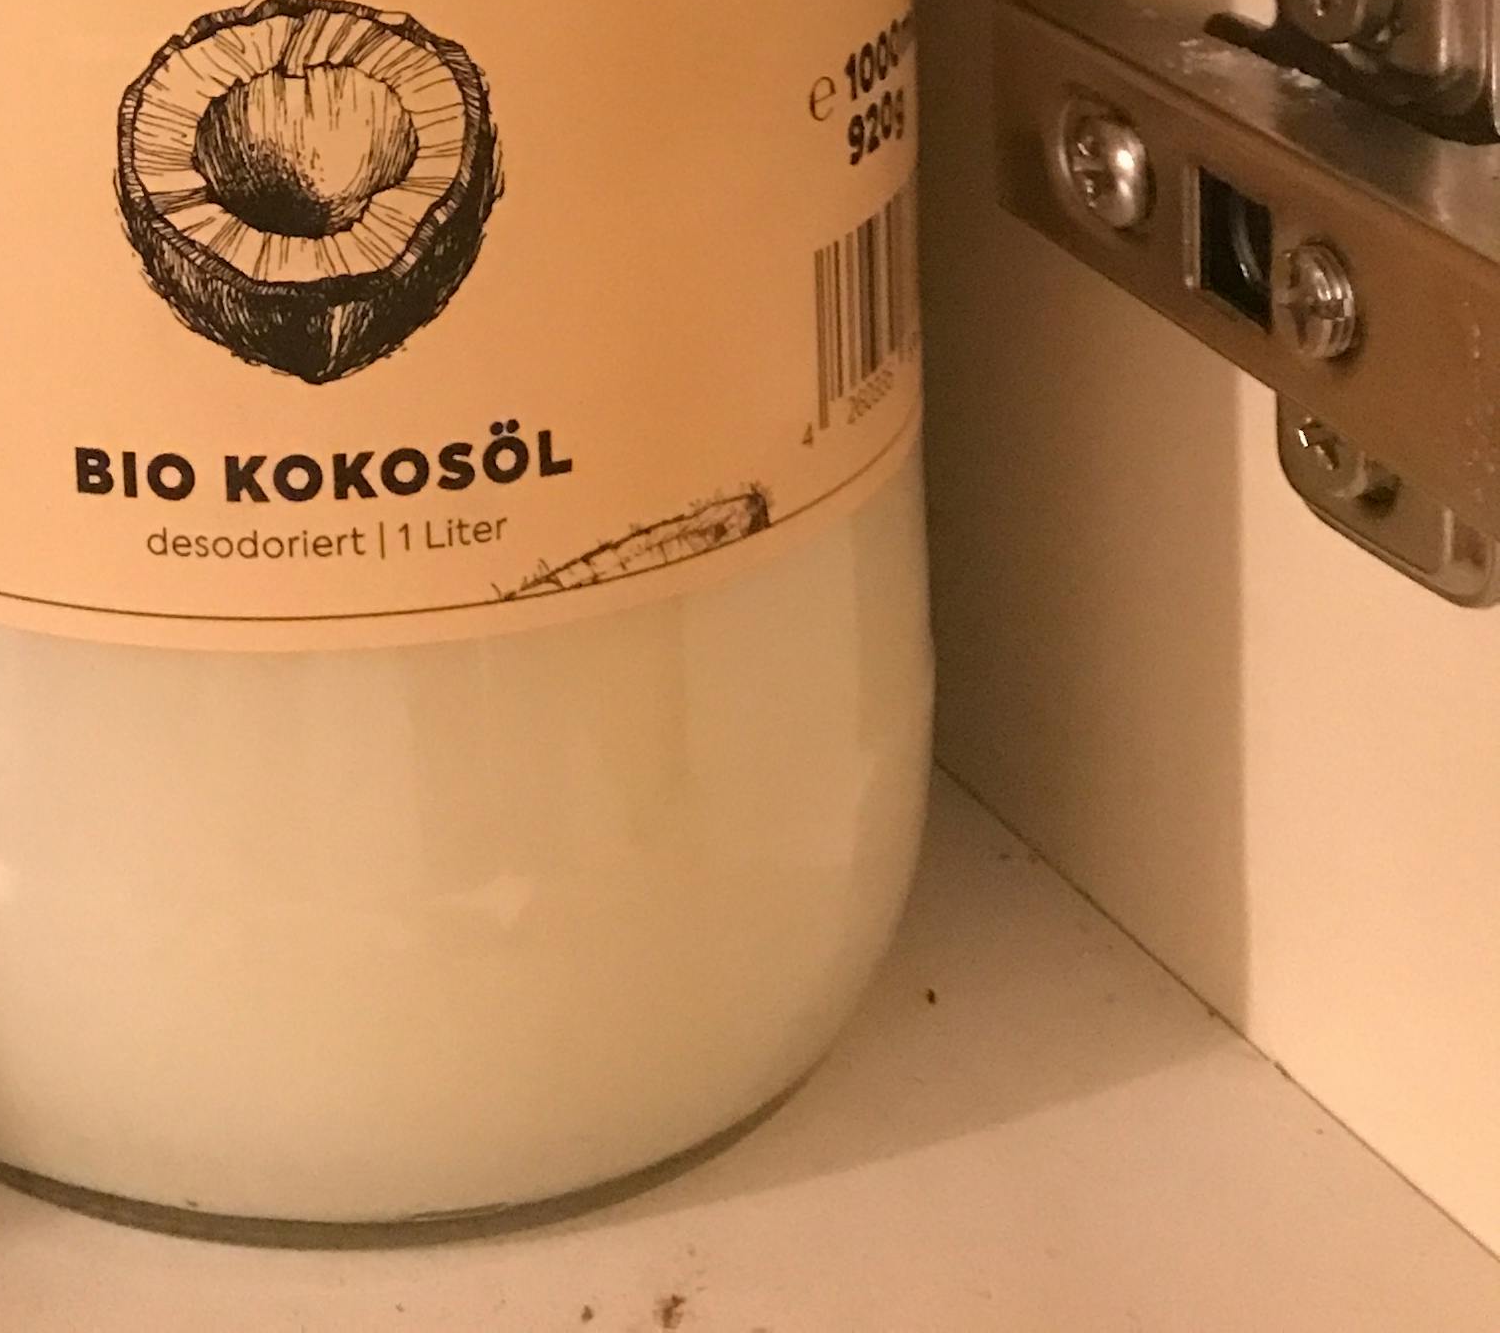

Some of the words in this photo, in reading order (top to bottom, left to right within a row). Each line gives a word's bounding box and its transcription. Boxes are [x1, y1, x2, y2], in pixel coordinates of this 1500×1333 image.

[74, 445, 196, 502] BIO
[224, 418, 573, 504] KOKOSÖL
[146, 527, 366, 561] desodoriert
[398, 524, 411, 553] 1
[424, 513, 508, 550] Liter
